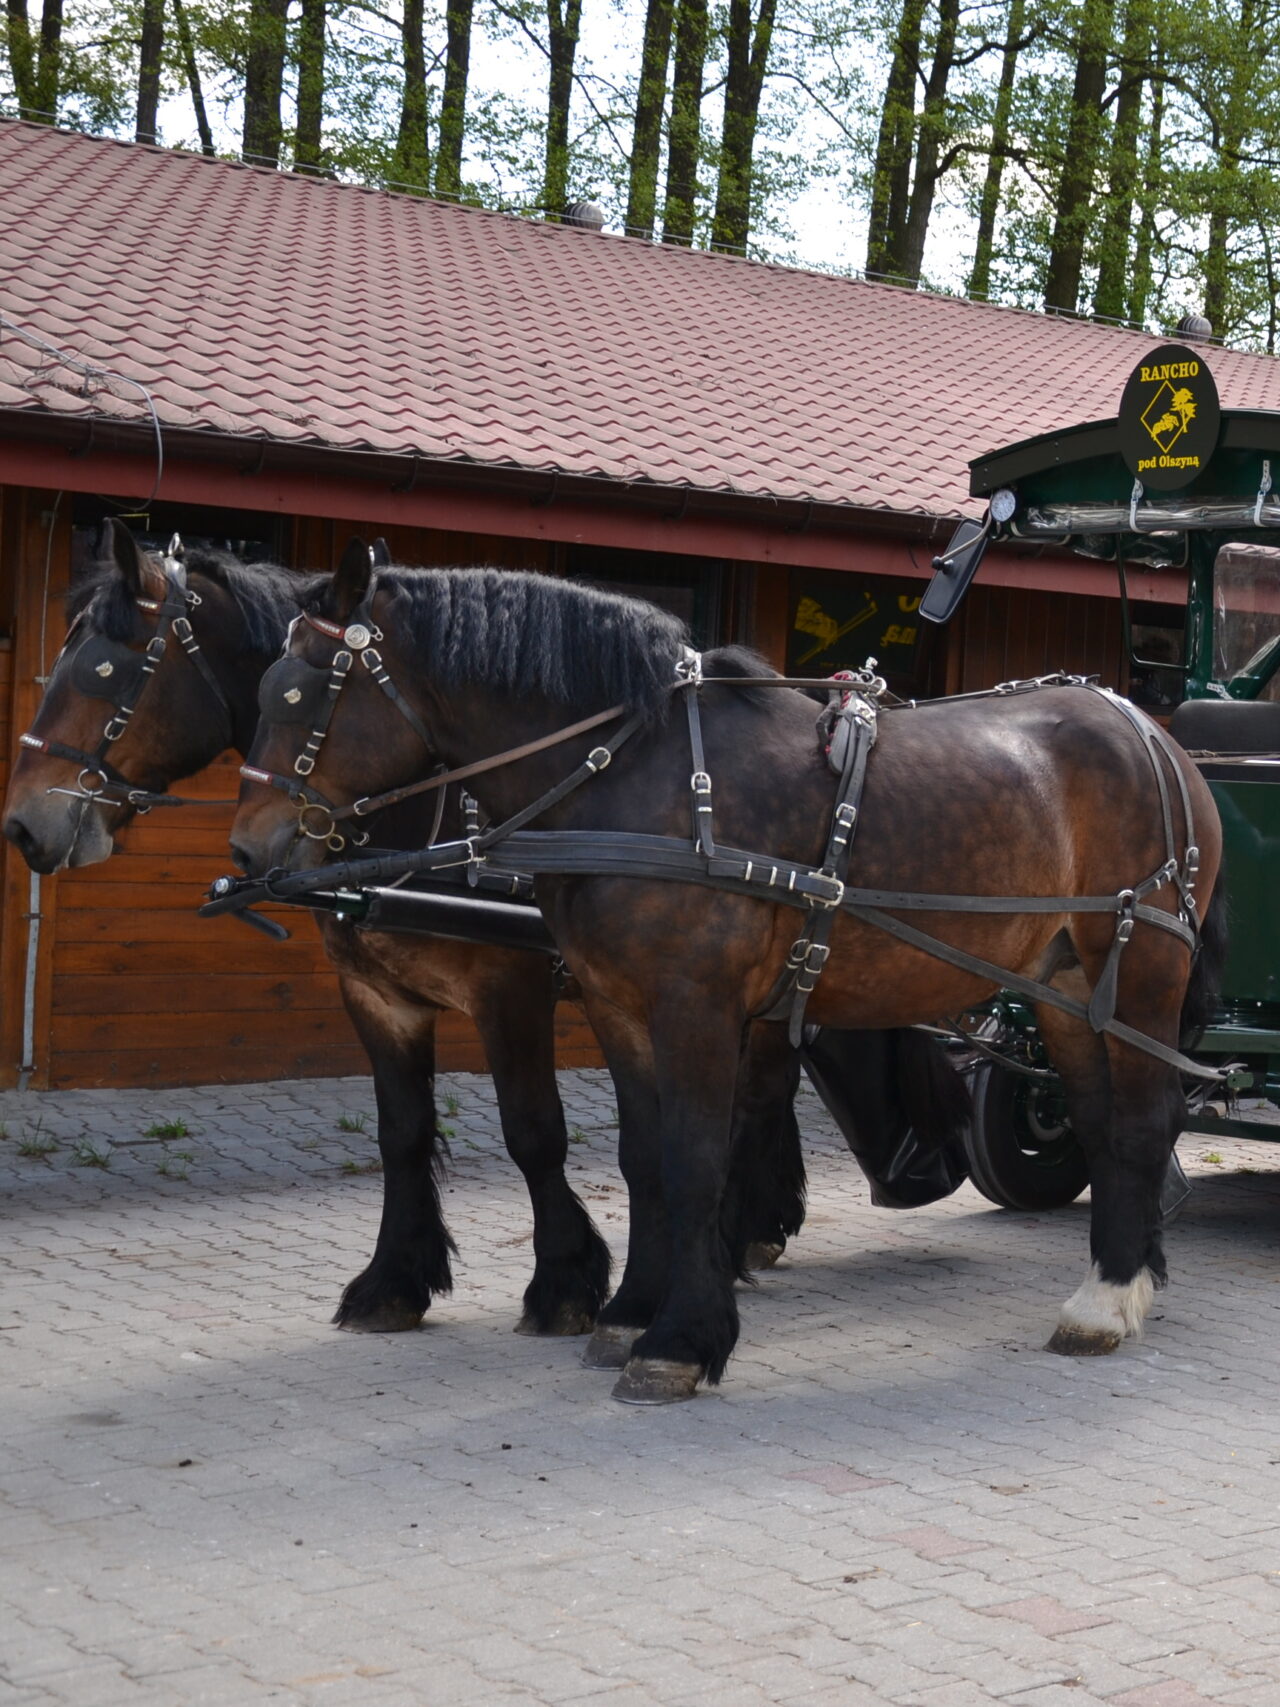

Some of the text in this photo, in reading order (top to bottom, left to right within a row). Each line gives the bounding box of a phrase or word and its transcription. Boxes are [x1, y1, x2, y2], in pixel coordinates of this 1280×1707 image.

[1140, 361, 1199, 382] RANCHO
[1138, 455, 1200, 472] pod Olszyną
